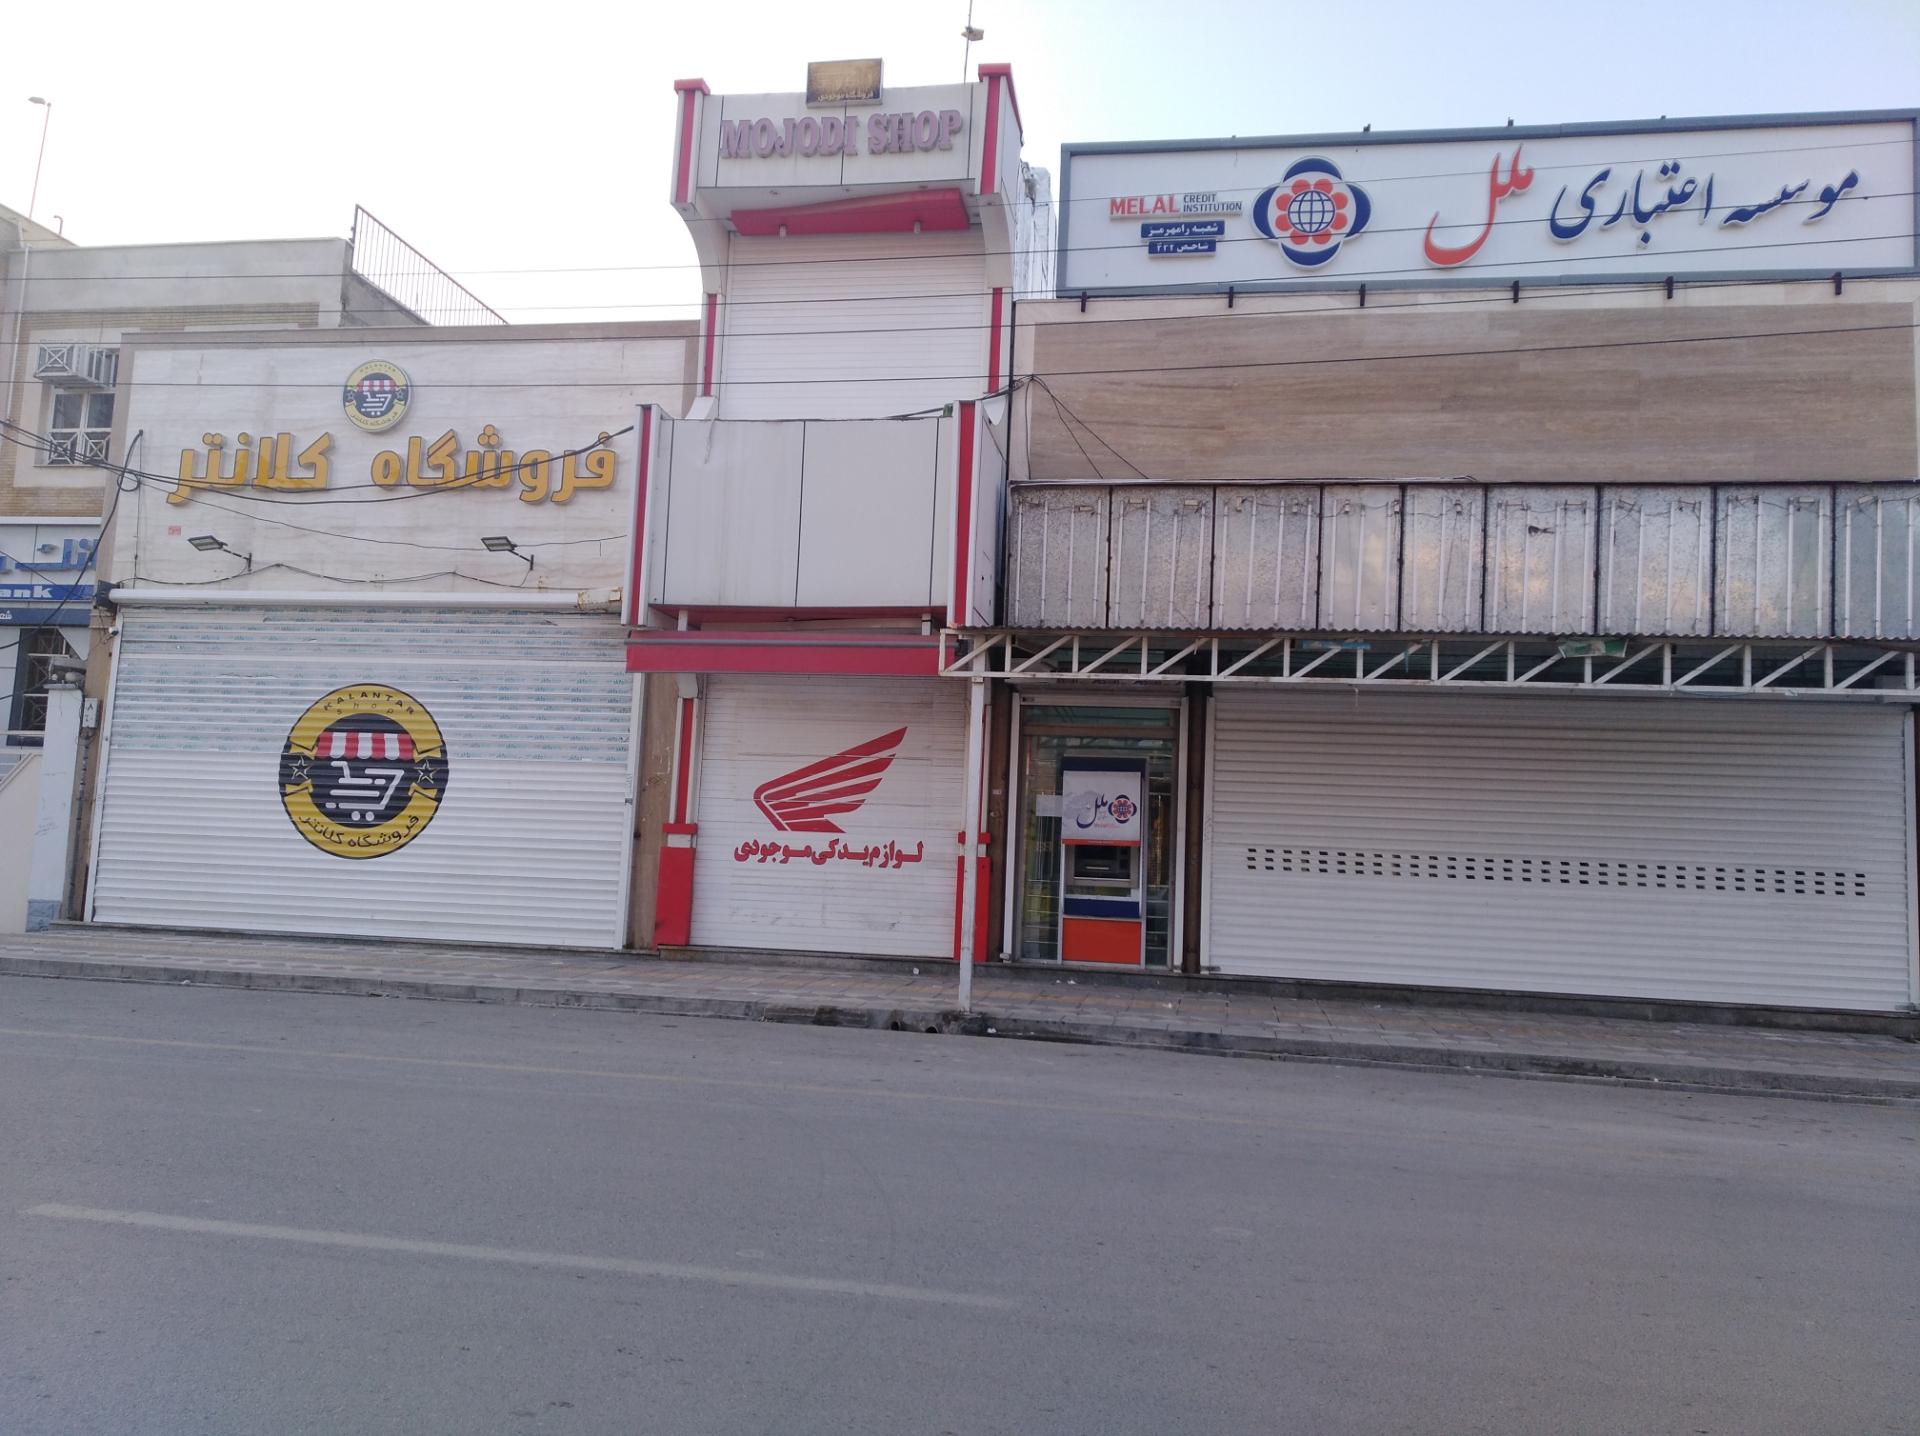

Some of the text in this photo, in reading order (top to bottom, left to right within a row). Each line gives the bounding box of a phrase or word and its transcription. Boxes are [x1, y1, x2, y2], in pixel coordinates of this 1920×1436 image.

[720, 109, 962, 159] MOJODI SHOP
[1110, 194, 1179, 215] MELAL
[1183, 193, 1217, 203] CREDIT
[1183, 201, 1242, 213] INSTITUTION
[1423, 143, 1860, 268] موسسه اعتباری ملل
[1148, 222, 1218, 237] شعبه رامهرمز
[1176, 241, 1209, 253] شاخص
[167, 424, 617, 504] فروشگاه کلانتر
[0, 585, 53, 598] ank
[324, 691, 415, 715] KALANTAR
[298, 814, 420, 848] فروشگاه کلانتر
[733, 838, 925, 869] لوازم یدکی موجودی
